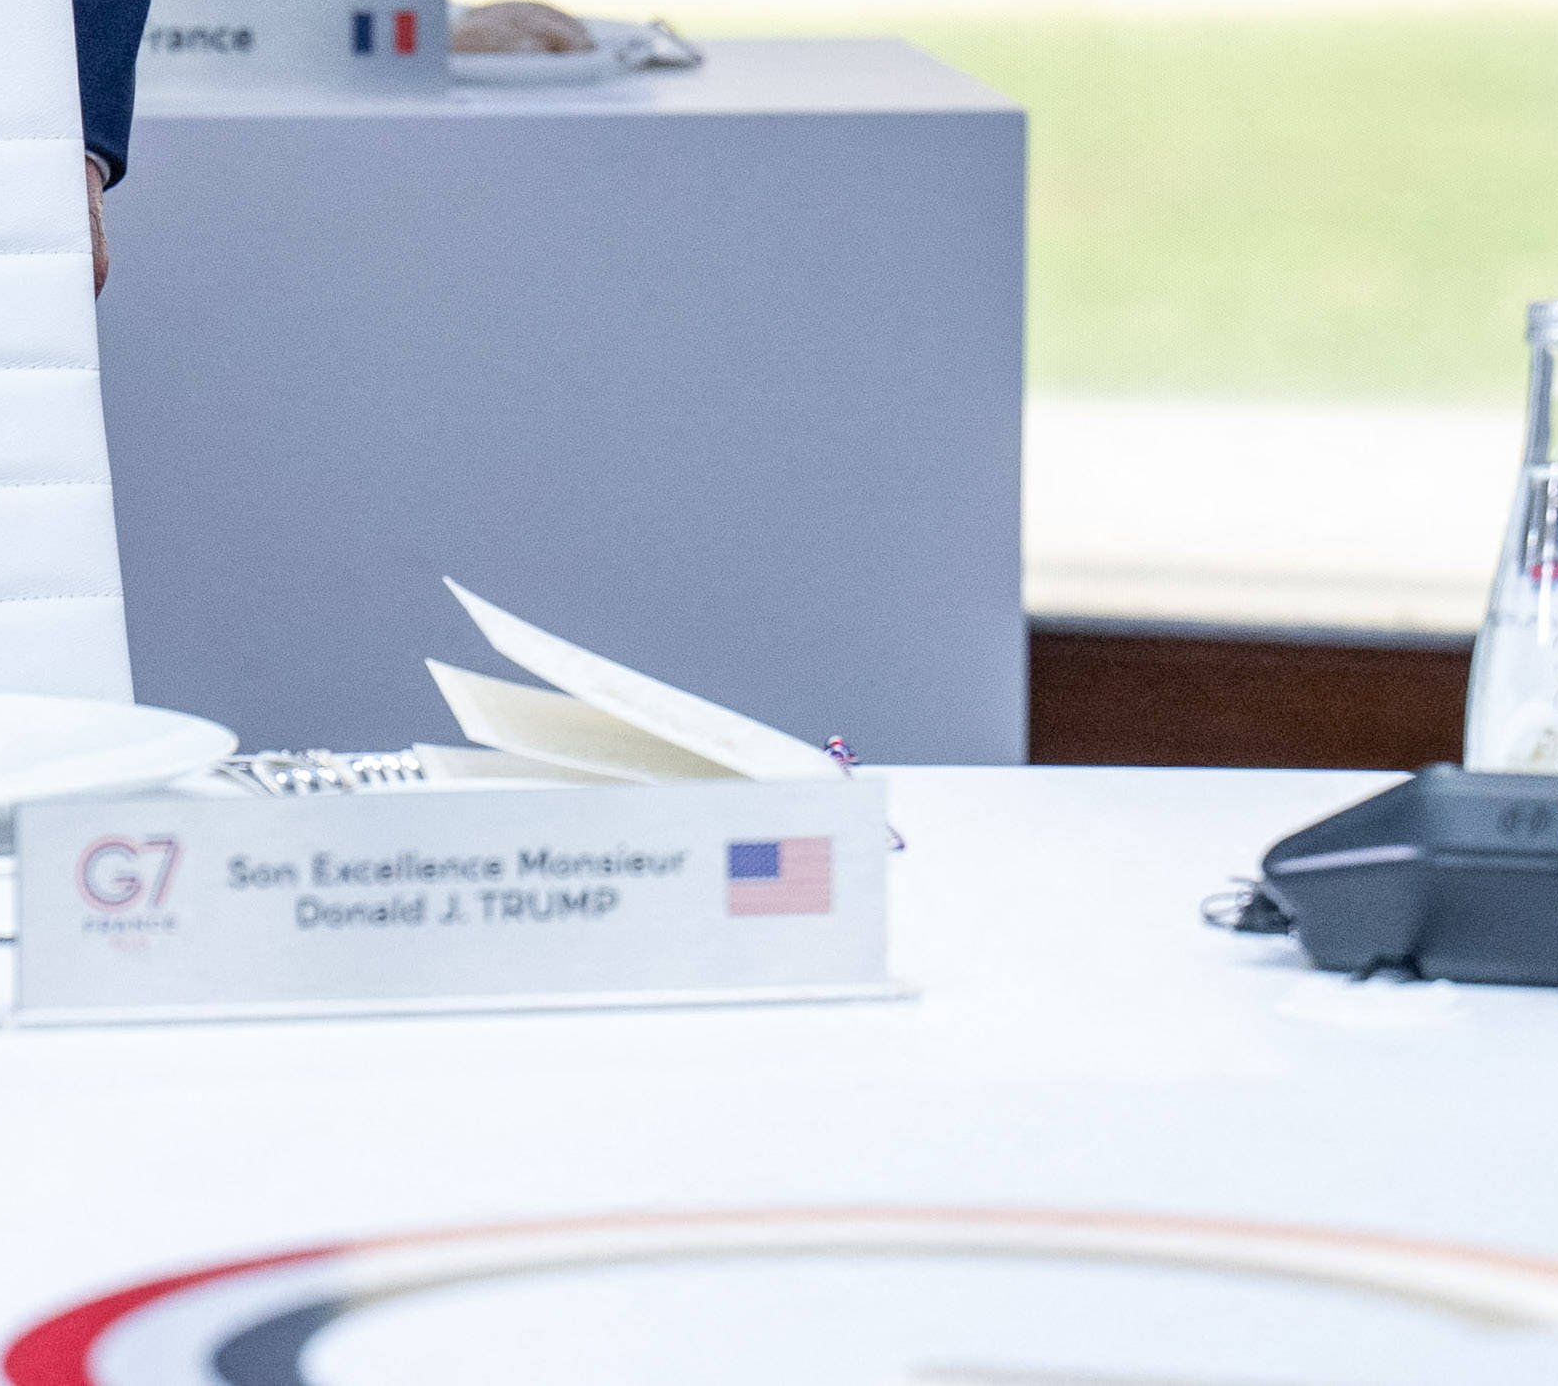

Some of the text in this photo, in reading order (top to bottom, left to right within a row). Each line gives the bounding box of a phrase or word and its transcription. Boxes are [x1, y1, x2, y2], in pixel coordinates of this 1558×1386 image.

[149, 24, 254, 53] rance
[75, 833, 183, 911] G7
[228, 843, 688, 890] Son Excellence Monsieur
[295, 893, 426, 930] Donald
[475, 885, 621, 924] TRUMP
